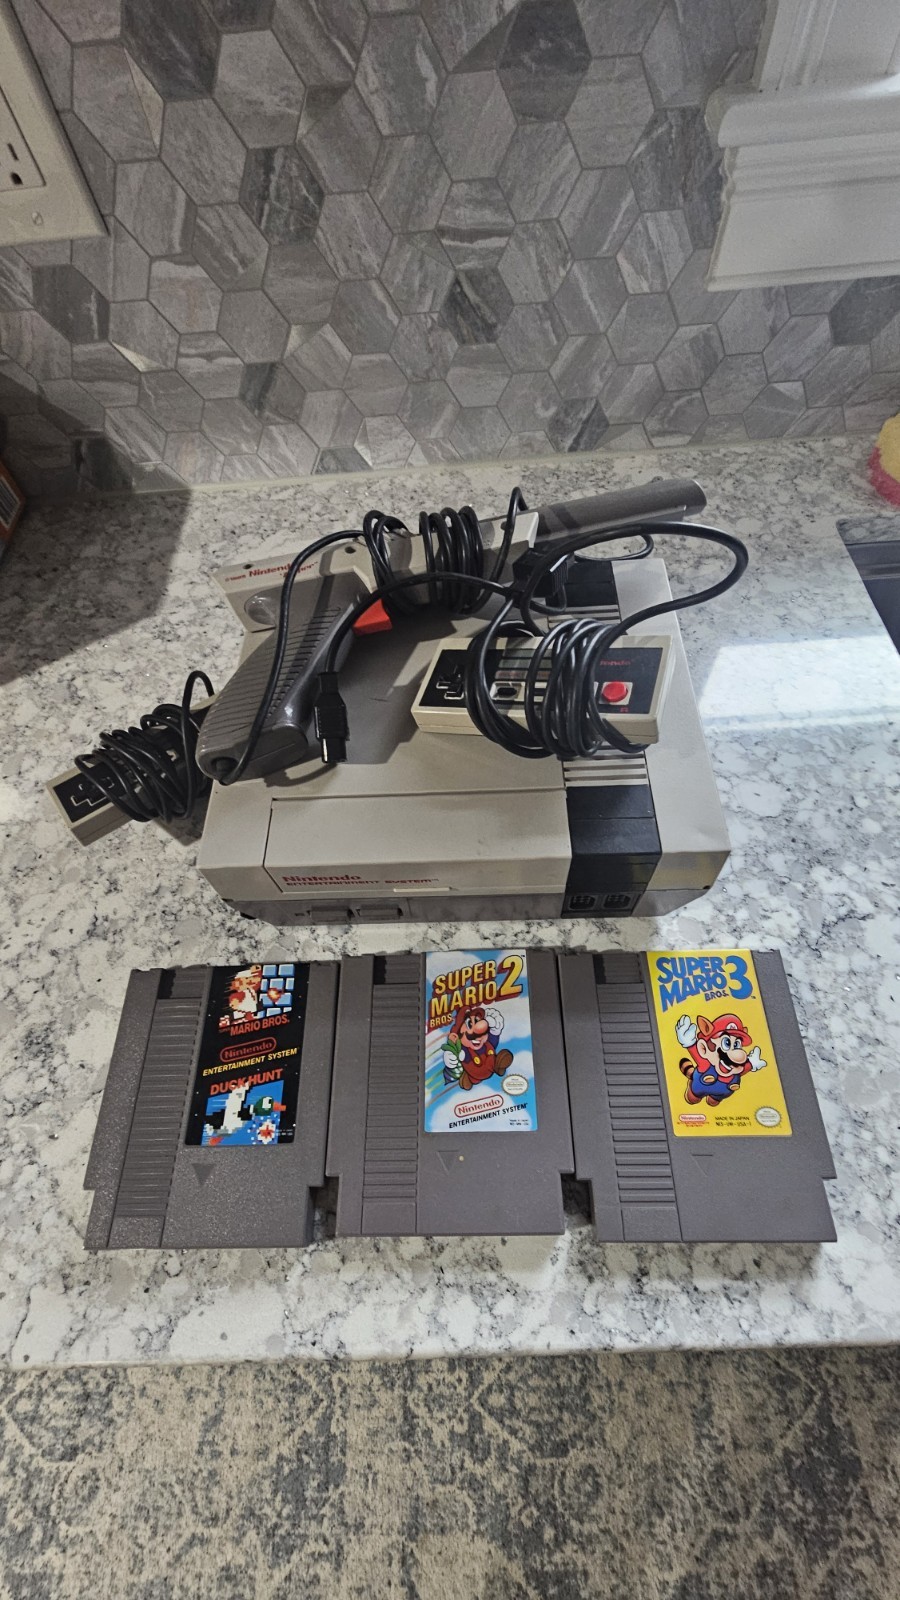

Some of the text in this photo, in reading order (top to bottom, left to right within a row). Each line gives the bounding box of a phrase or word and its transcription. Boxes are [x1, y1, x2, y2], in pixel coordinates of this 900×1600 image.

[249, 563, 292, 577] Nintend
[282, 874, 361, 882] Nintendo
[435, 954, 525, 999] SUPER 2
[656, 955, 753, 1000] SUPER 3
[430, 980, 498, 1018] MARIO
[659, 972, 727, 1013] MARIO
[704, 989, 730, 1001] BROS.
[230, 1020, 261, 1037] MARIO
[261, 1013, 290, 1030] BROS.
[202, 1047, 298, 1077] ENTERTAINMENT SYSTEM
[224, 1041, 273, 1059] Nintendo
[209, 1068, 284, 1096] DUCK HUNT
[448, 1103, 528, 1129] ENTERTAINMENT SYSTEM
[457, 1097, 501, 1115] Nintendo
